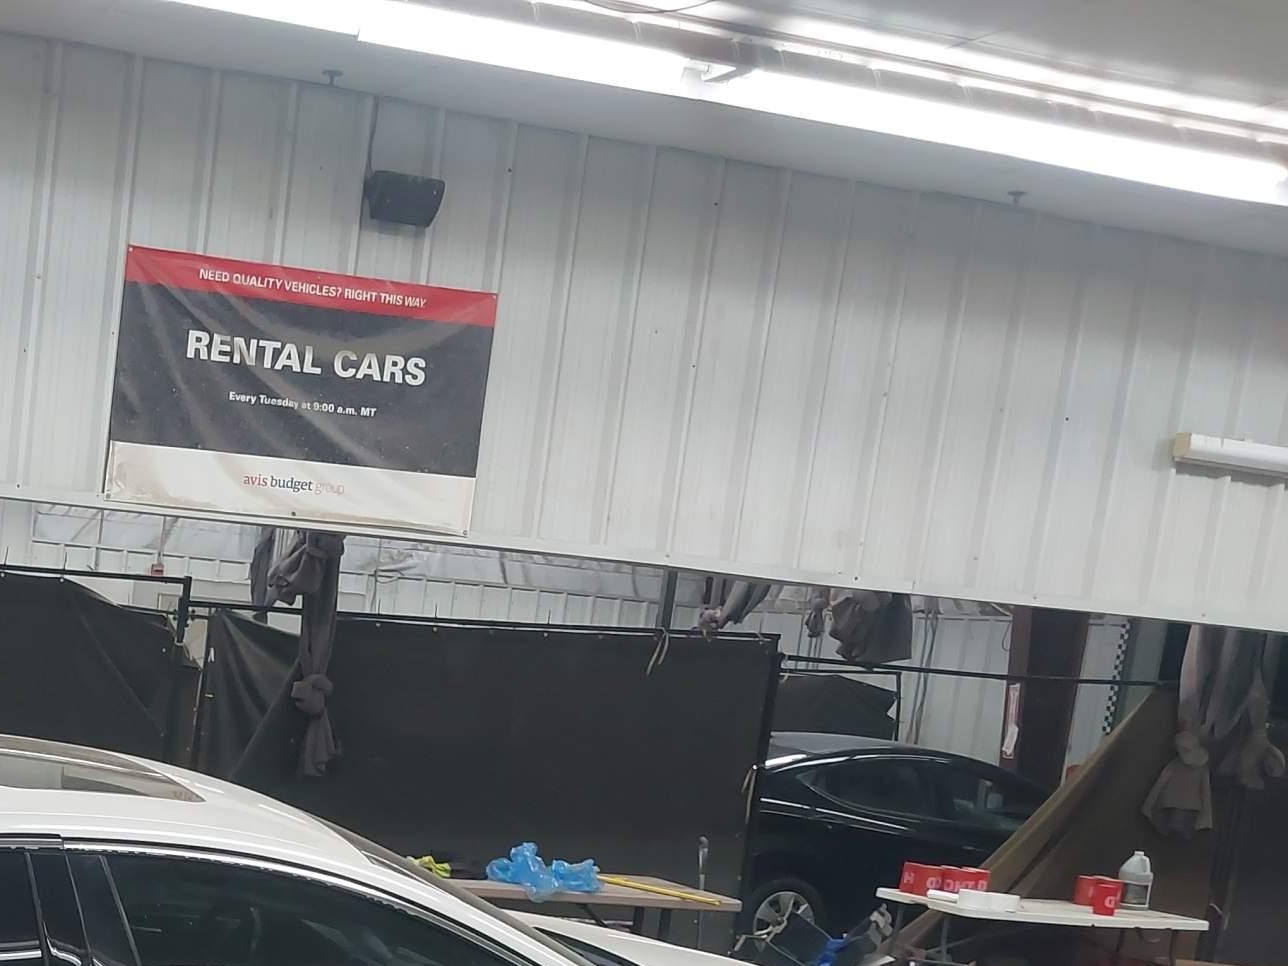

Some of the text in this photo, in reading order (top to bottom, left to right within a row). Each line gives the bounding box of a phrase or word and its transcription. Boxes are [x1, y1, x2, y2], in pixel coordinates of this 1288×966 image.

[199, 268, 427, 309] NEED QUALITY VEHICLES? RIGHT THIS WAY
[185, 329, 427, 386] RENTAL CARS
[228, 391, 377, 417] Every Tuesday at 9:00 a.m. MT
[243, 473, 268, 488] avis
[270, 475, 313, 493] budget
